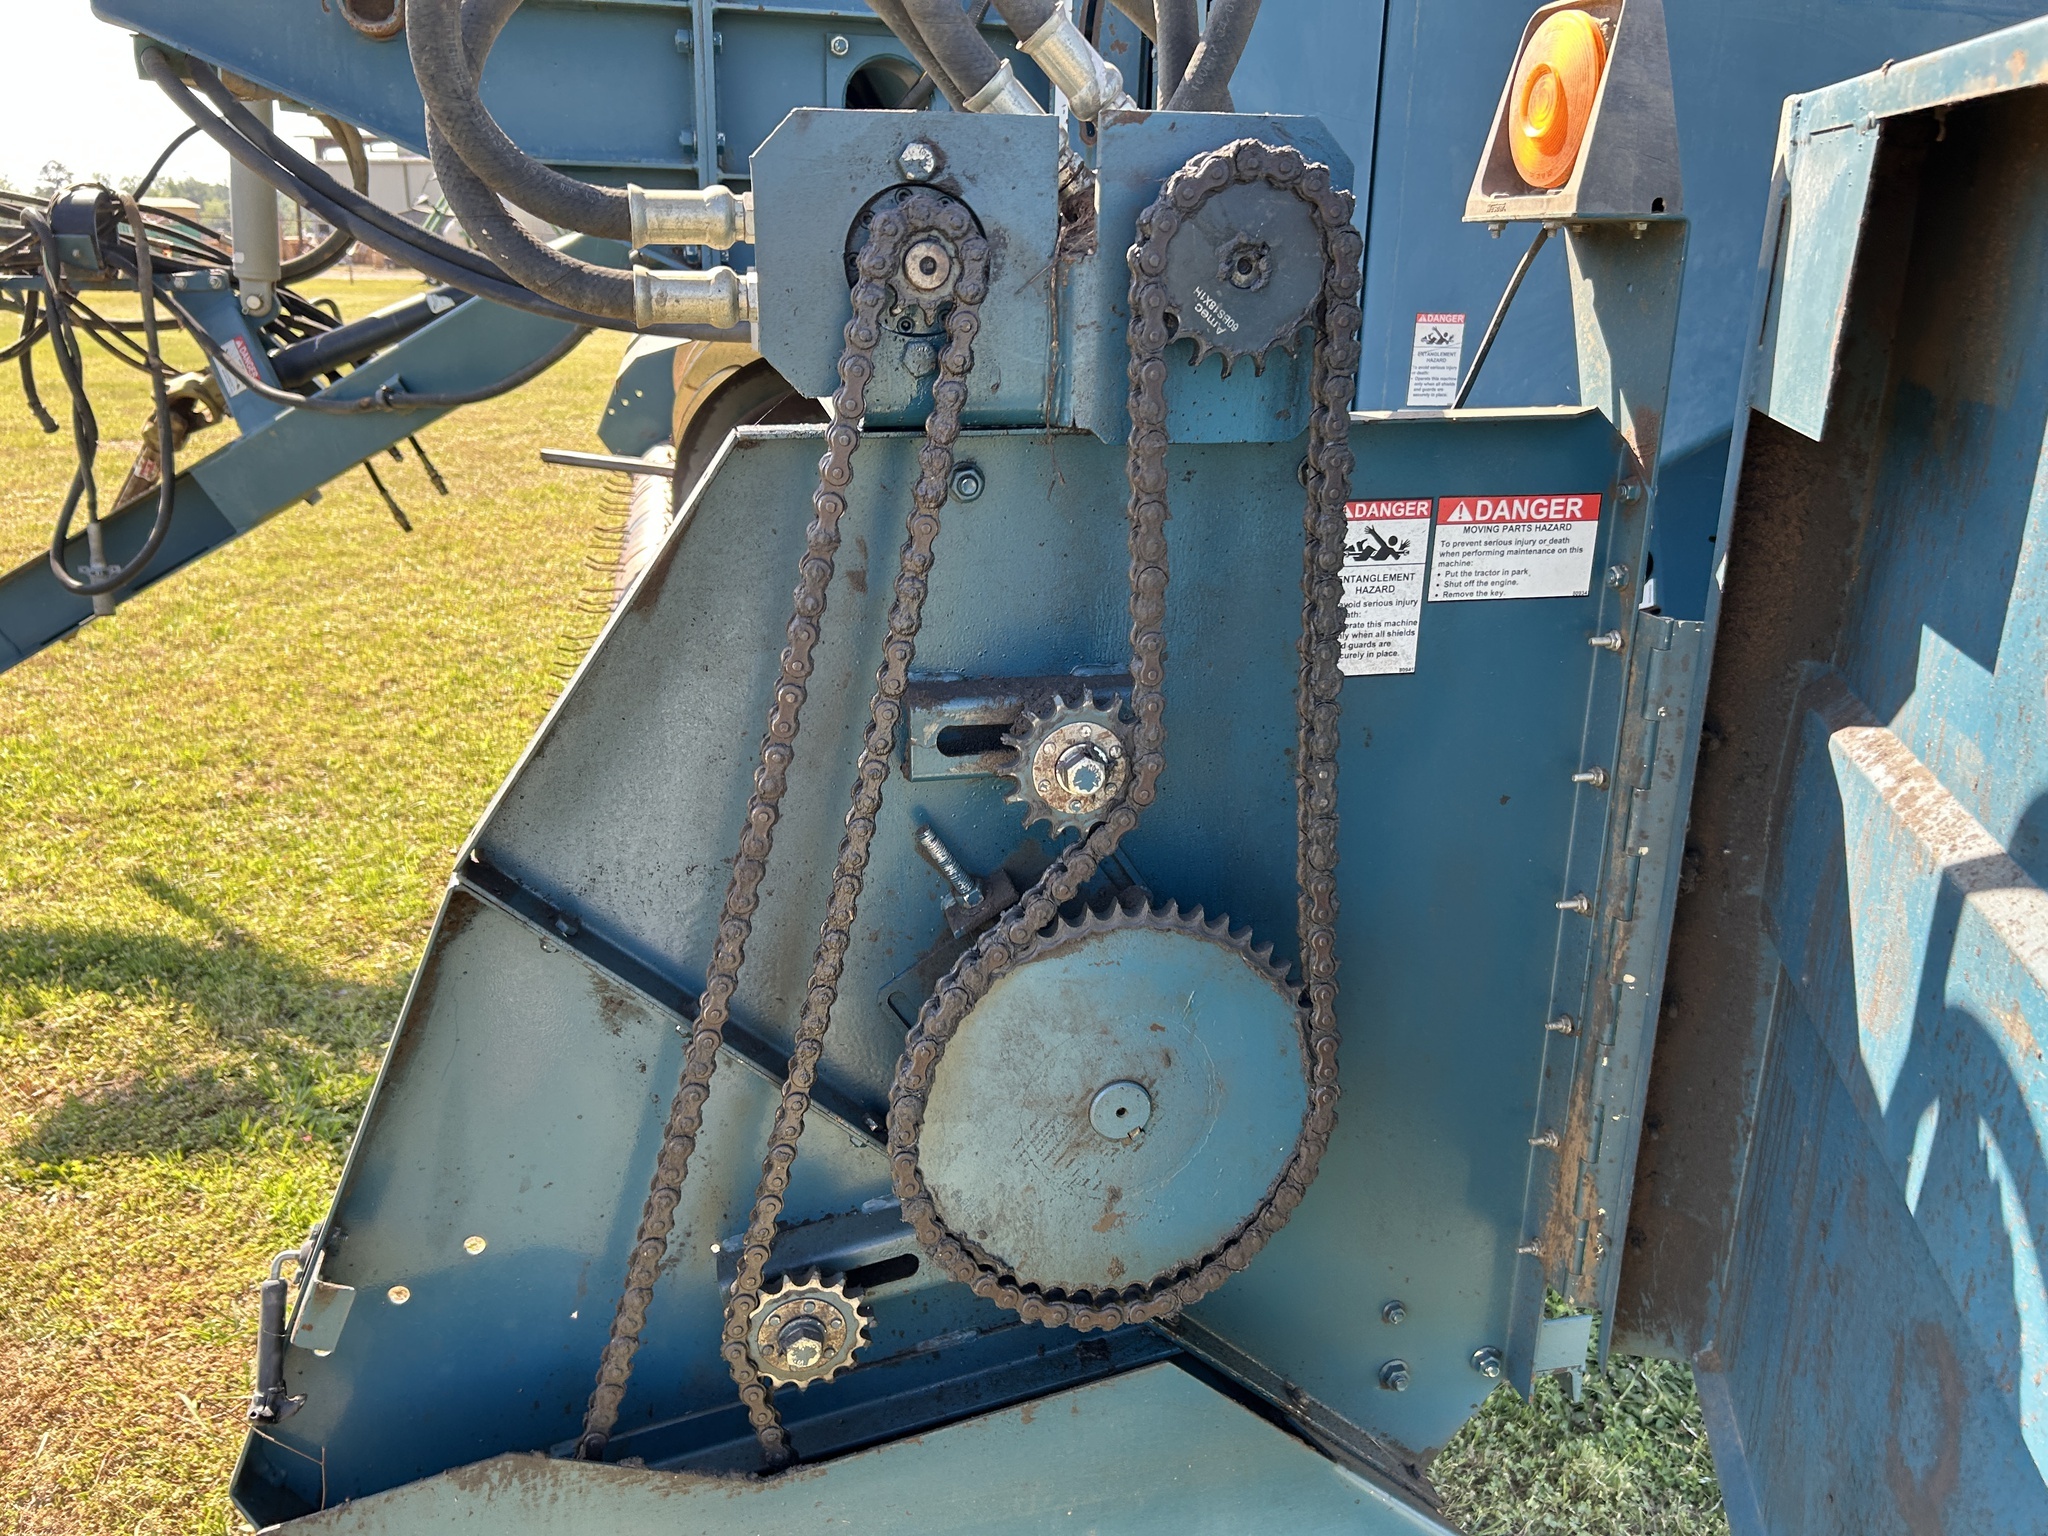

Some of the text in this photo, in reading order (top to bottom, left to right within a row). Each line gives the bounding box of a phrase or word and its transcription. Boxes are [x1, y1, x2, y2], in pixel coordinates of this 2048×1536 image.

[1194, 303, 1226, 335] Amec
[1355, 501, 1429, 517] DANGER
[1475, 498, 1583, 521] DANGER
[1463, 523, 1572, 534] MOVING PARTS HAZARD
[1452, 540, 1482, 548] prevent
[1515, 539, 1536, 547] injury
[1462, 549, 1504, 558] performing
[1506, 548, 1556, 556] maintenance
[1491, 579, 1518, 587] engine.
[1356, 585, 1395, 594] HAZARD
[1384, 619, 1417, 627] machine
[1348, 641, 1376, 650] guards
[1376, 650, 1399, 659] place.
